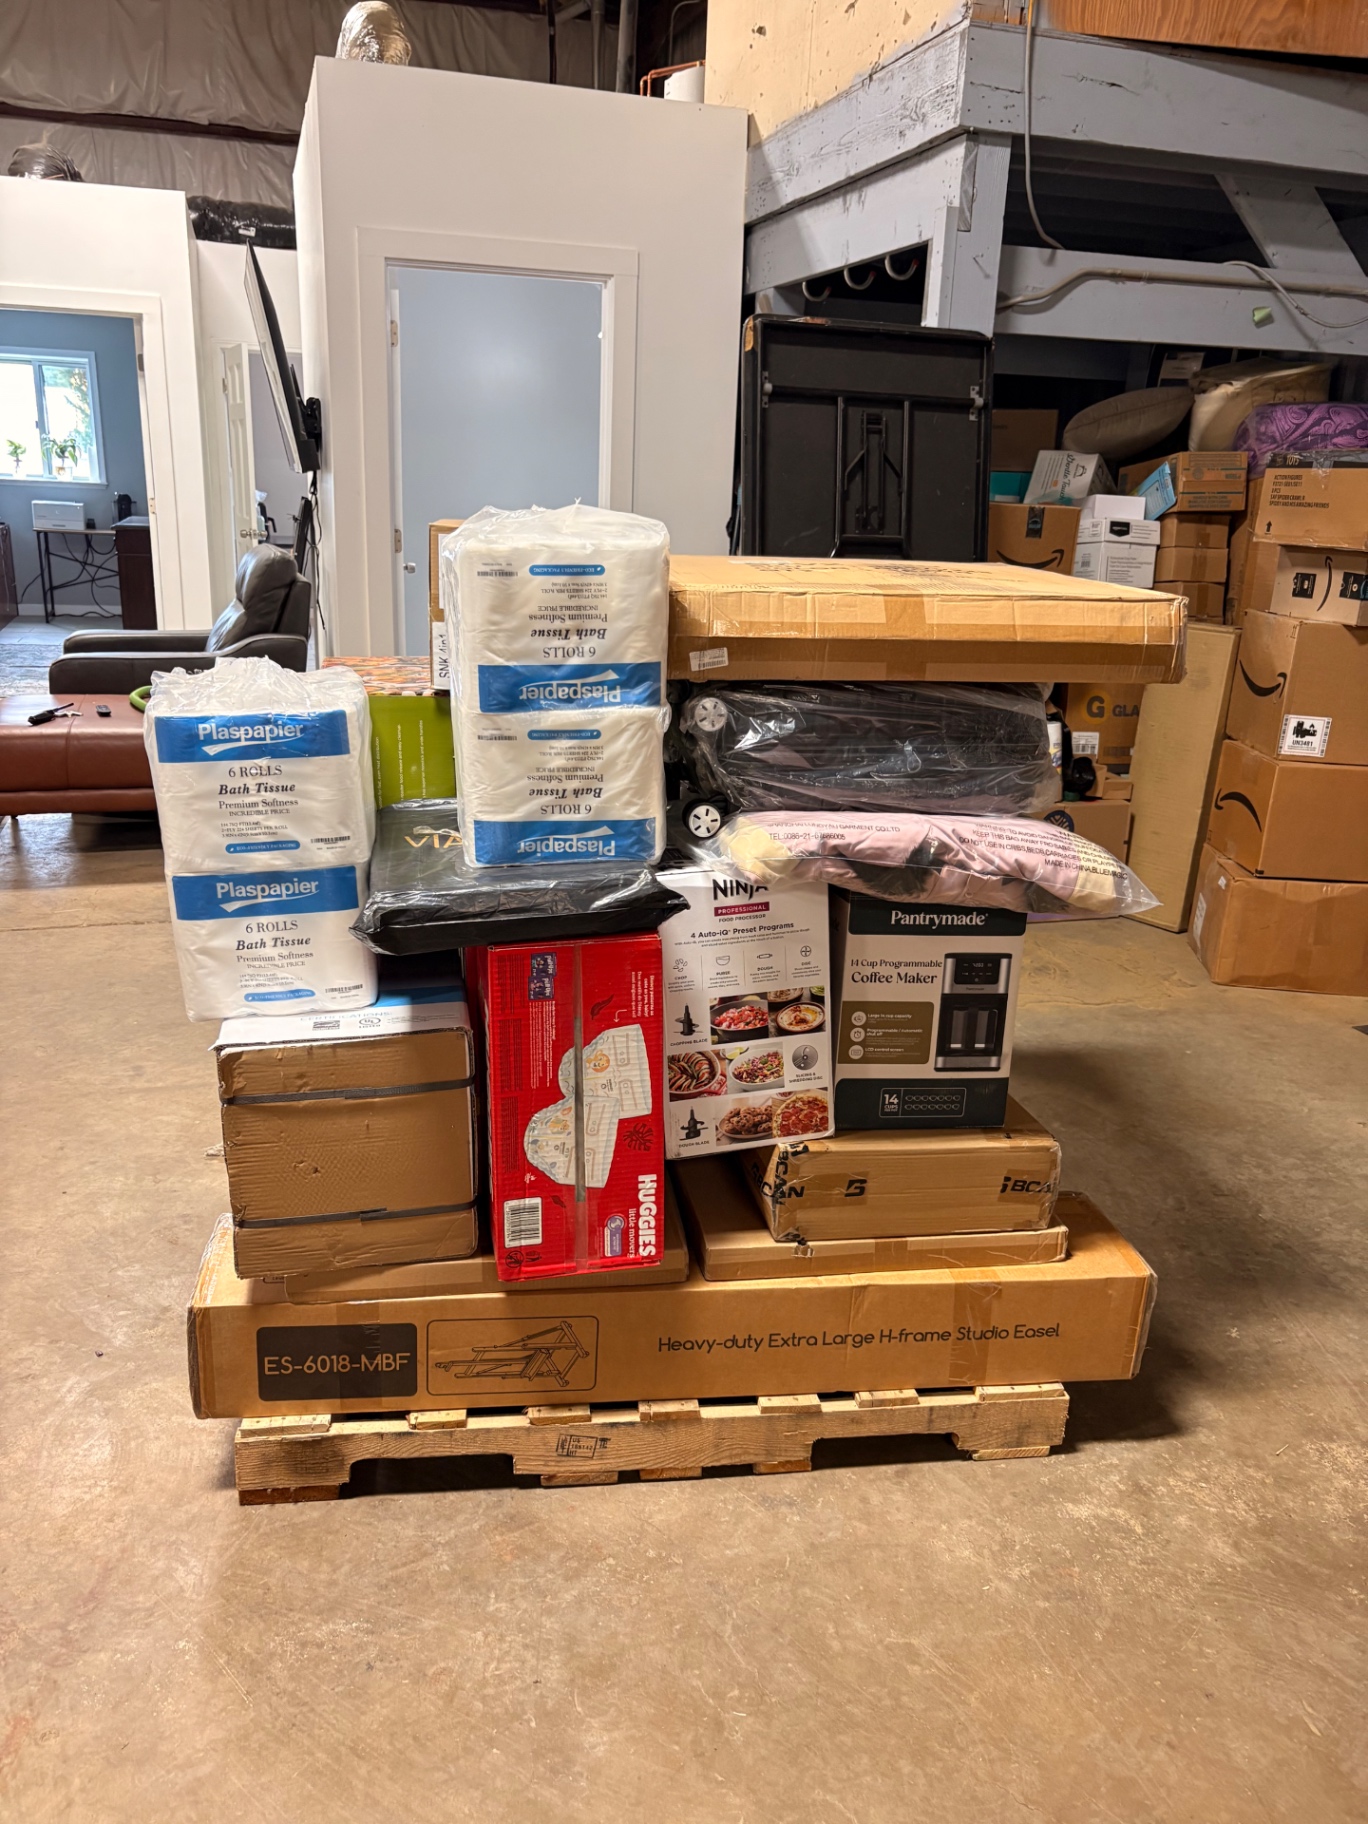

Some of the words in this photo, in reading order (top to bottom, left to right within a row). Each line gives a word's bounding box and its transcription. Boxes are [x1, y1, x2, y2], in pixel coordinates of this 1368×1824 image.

[528, 613, 566, 623] Softness
[569, 613, 608, 622] Premium
[530, 628, 571, 640] Tissue
[576, 628, 607, 640] Bath
[543, 646, 585, 658] ROLLS
[588, 646, 596, 657] 6
[438, 656, 450, 679] SNK
[519, 682, 621, 703] Plaspapier
[1086, 695, 1105, 719] G
[1112, 704, 1140, 718] GLA
[198, 722, 304, 743] Plaspapier
[228, 767, 236, 778] 6
[239, 765, 283, 778] ROLLS
[564, 773, 604, 782] Premium
[526, 773, 563, 783] Softness
[218, 783, 250, 795] Bath
[254, 782, 296, 794] Tissue
[529, 787, 568, 799] Tissue
[572, 787, 604, 799] Bath
[218, 800, 259, 810] Premium
[261, 798, 299, 808] Softness
[540, 804, 581, 815] ROLLS
[584, 804, 592, 814] 6
[229, 809, 269, 817] INCREDIBLE
[959, 836, 970, 844] DO
[972, 829, 990, 838] KEEP
[990, 831, 1005, 840] THIS
[1005, 834, 1020, 842] BAG
[517, 835, 616, 856] Plaspapier
[1044, 858, 1064, 868] MADE
[1064, 861, 1071, 869] IN
[216, 880, 319, 900] Plaspapier
[717, 905, 766, 915] PROFESSIONAL
[734, 913, 766, 922] PROCESSOR
[890, 910, 986, 930] Pantrymade
[245, 922, 253, 934] 6
[256, 920, 298, 933] ROLLS
[732, 926, 757, 935] Preset
[758, 922, 794, 932] Programs
[235, 939, 267, 951] Bath
[271, 937, 311, 948] Tissue
[236, 954, 276, 963] Premium
[277, 951, 314, 961] Softness
[850, 959, 860, 967] 14
[860, 959, 878, 969] Cup
[879, 959, 943, 970] Programmable
[851, 971, 893, 984] Coffee
[896, 972, 938, 984] Maker
[884, 1094, 899, 1105] 14
[628, 1208, 637, 1228] little
[637, 1173, 658, 1257] HUGGIES
[628, 1228, 636, 1258] movers
[658, 1334, 764, 1354] Heavy-duty
[768, 1332, 818, 1348] Extra
[822, 1331, 875, 1348] Large
[879, 1328, 951, 1343] H-frame
[956, 1325, 1009, 1341] Studio
[1013, 1322, 1060, 1339] Easel
[264, 1352, 411, 1375] ES-6018-MBF
